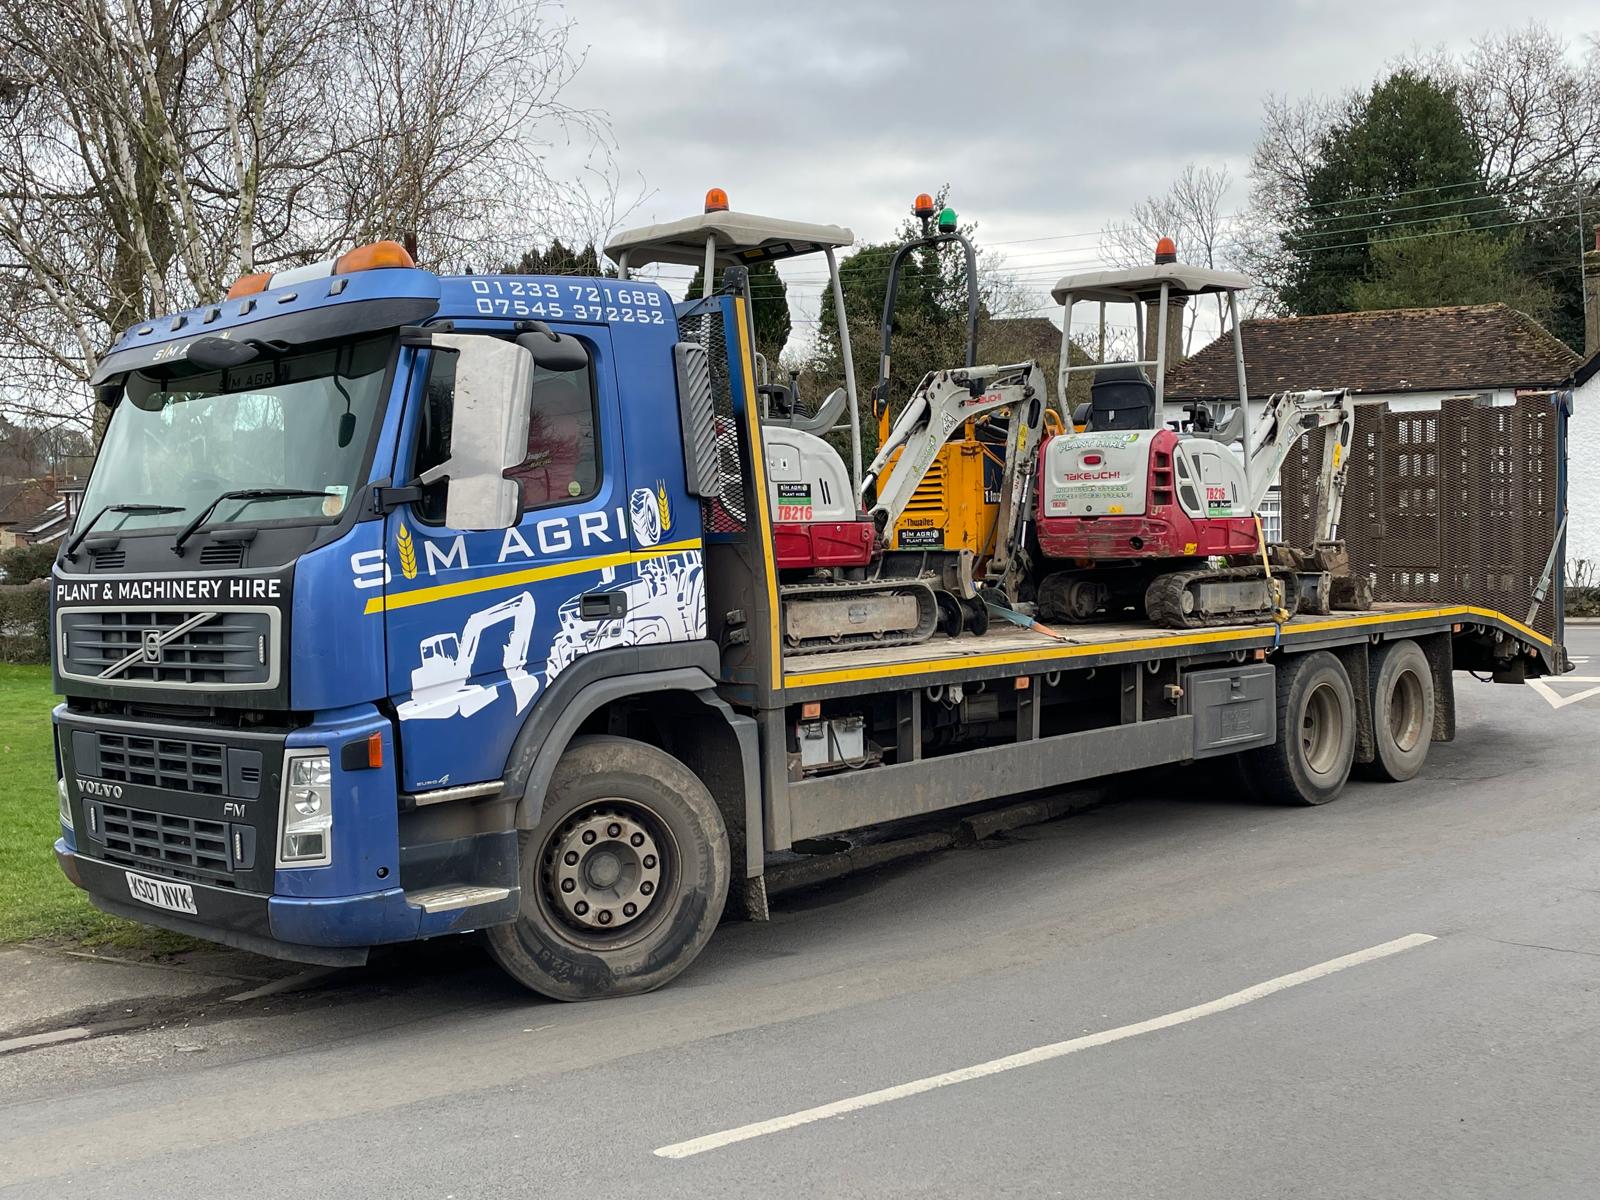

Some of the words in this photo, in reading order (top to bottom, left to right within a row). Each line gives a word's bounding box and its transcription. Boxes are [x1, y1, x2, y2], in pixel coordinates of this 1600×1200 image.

[471, 280, 560, 298] 01233
[569, 285, 661, 307] 721688
[476, 297, 564, 318] 07545
[573, 304, 665, 325] 372252
[1063, 471, 1121, 481] TAKEUCHI
[1206, 487, 1226, 500] TB216
[777, 505, 813, 521] TB216
[906, 518, 934, 527] Thwaites
[497, 506, 628, 563] AGRI
[56, 583, 99, 602] PLANT
[102, 582, 113, 600] &
[118, 580, 223, 600] MACHINERY
[229, 579, 282, 598] HIRE
[76, 779, 123, 799] VOLVO
[223, 802, 246, 818] FM
[130, 875, 160, 904] KS07
[160, 886, 191, 910] NVK
